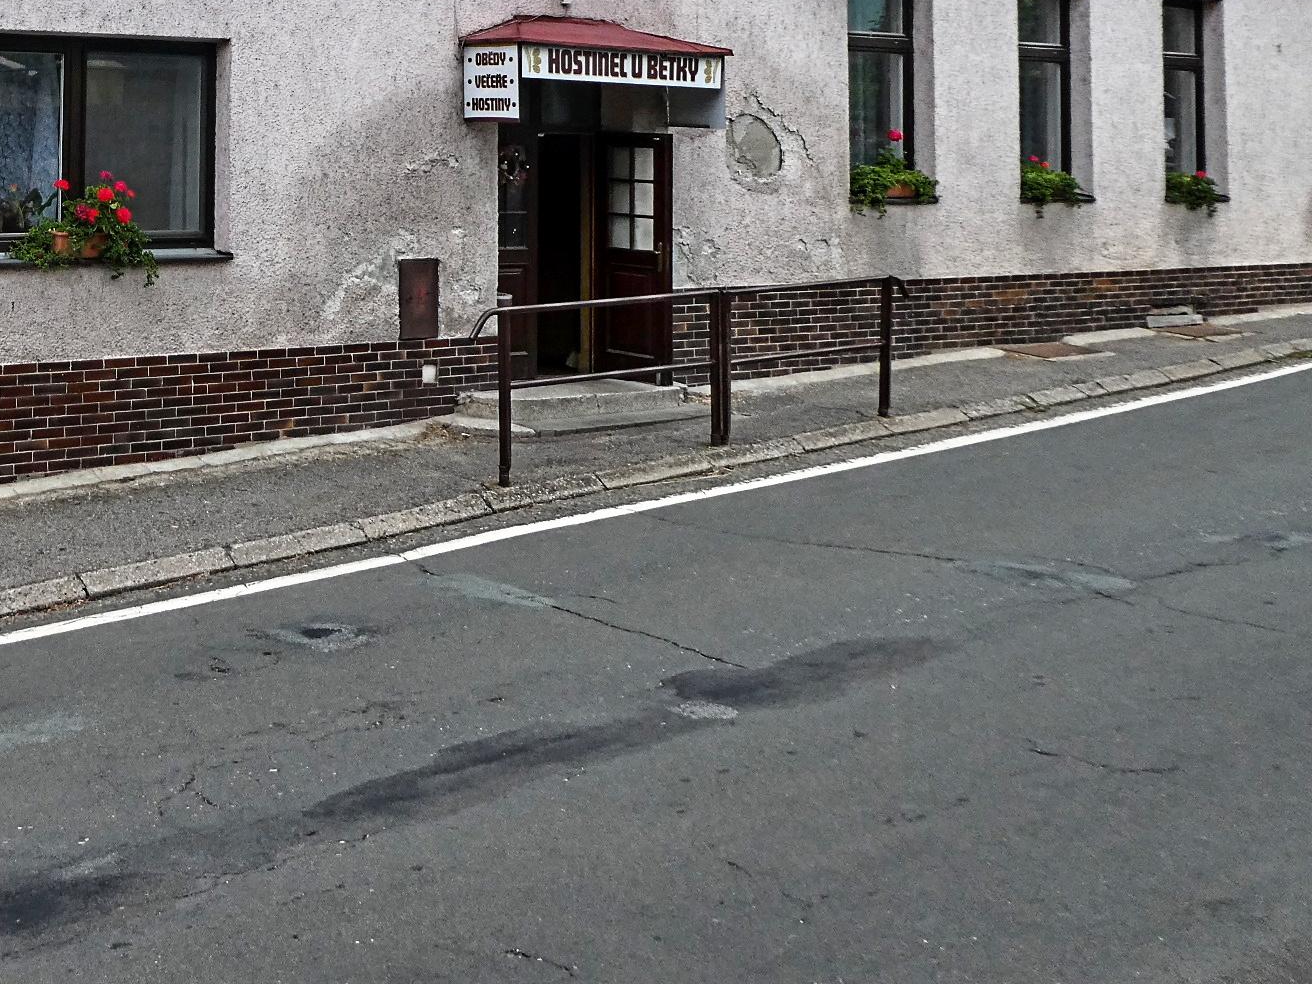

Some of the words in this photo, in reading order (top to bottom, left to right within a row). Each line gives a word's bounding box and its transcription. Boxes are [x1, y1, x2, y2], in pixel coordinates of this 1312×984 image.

[547, 48, 628, 78] HOSTINEC
[631, 54, 643, 79] U
[471, 97, 511, 112] HOSTINY
